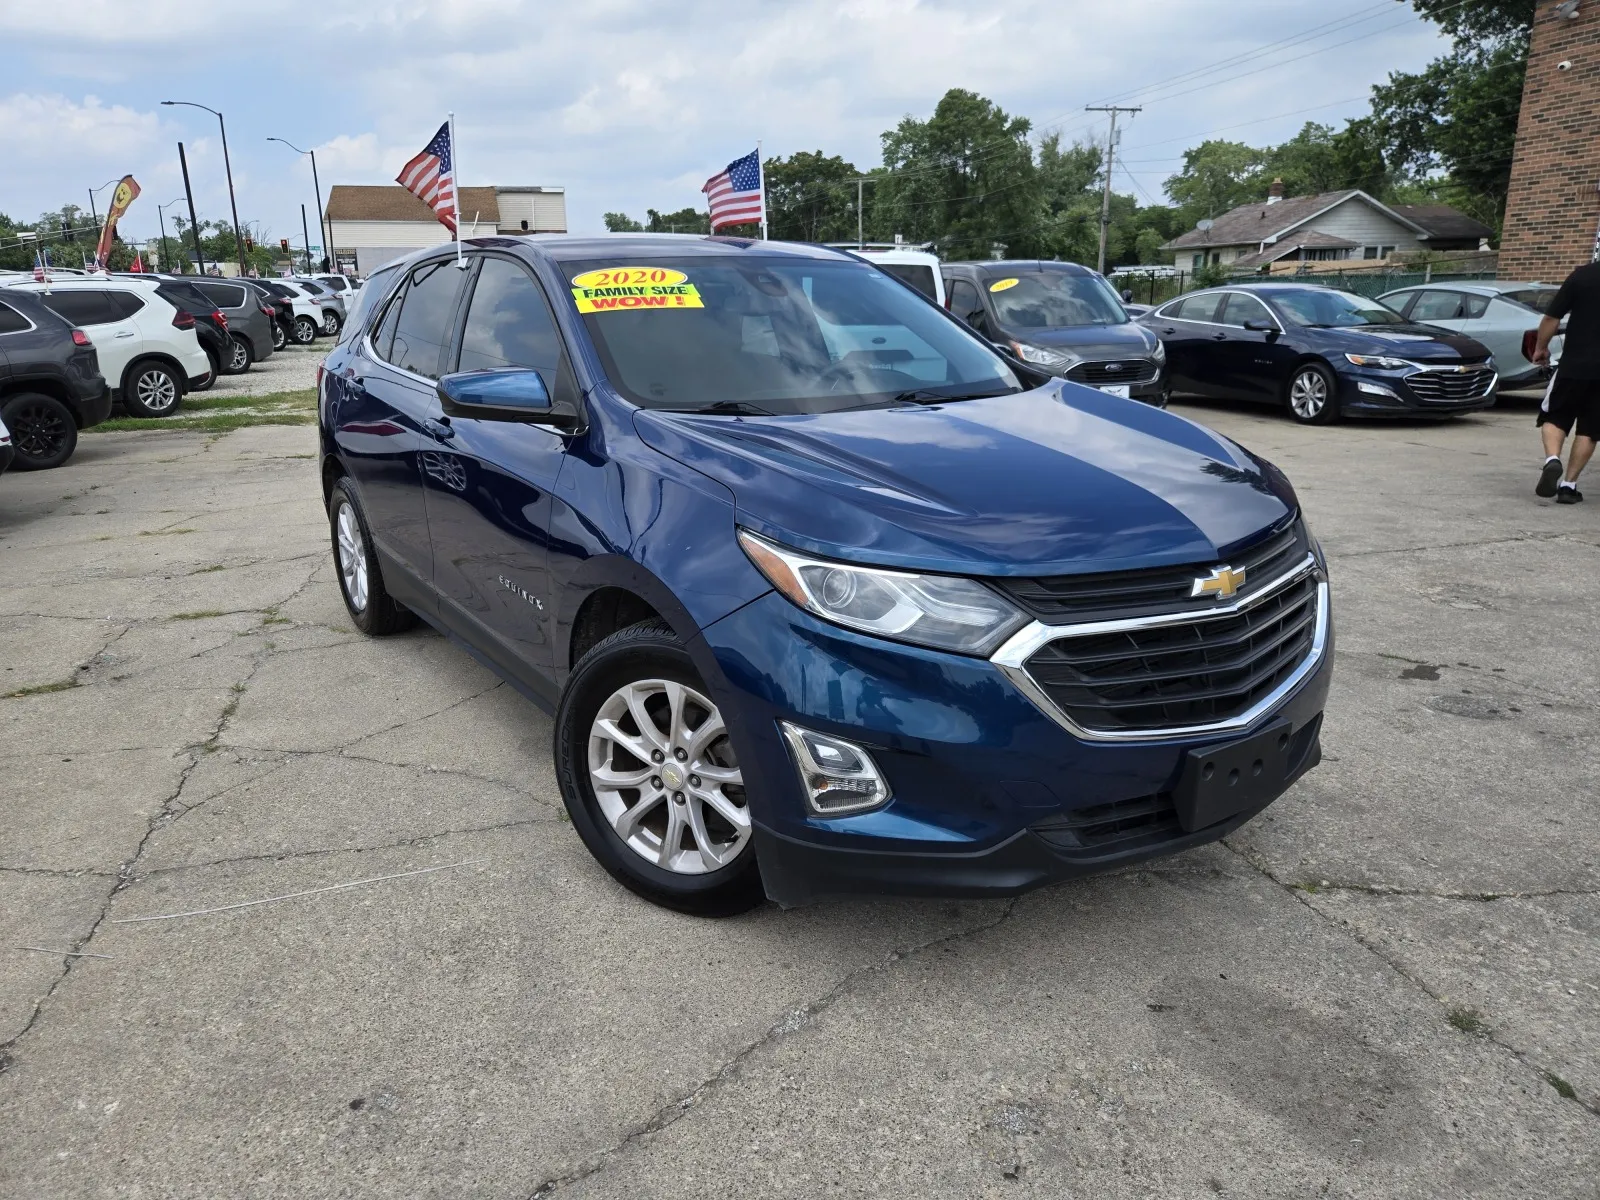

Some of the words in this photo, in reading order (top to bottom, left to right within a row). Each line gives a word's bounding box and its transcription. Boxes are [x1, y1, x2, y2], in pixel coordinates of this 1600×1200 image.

[594, 269, 667, 286] 2020
[583, 286, 646, 299] FAMILY
[651, 286, 689, 295] SIZE
[591, 297, 669, 309] WOW
[498, 574, 544, 611] EQUINOX
